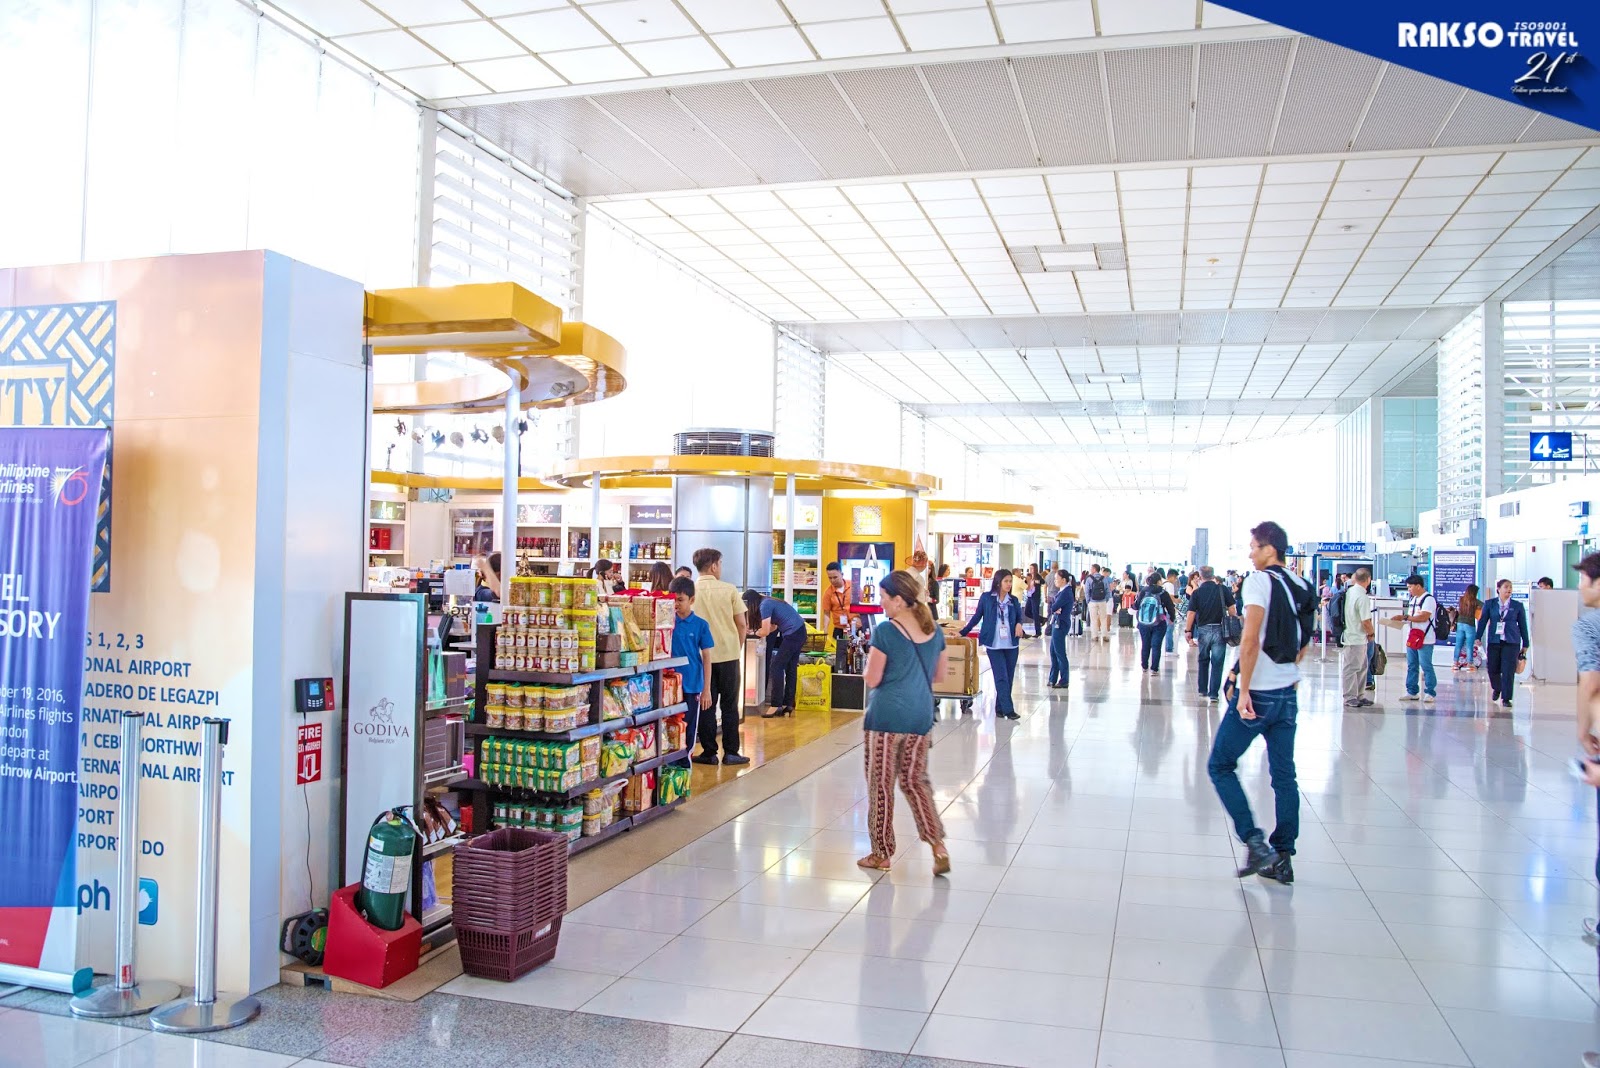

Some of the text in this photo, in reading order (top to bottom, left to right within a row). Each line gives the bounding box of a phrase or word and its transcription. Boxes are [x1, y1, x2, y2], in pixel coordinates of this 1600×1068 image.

[0, 377, 65, 426] TY
[1533, 435, 1552, 458] 4
[0, 480, 35, 494] rlines
[0, 573, 30, 602] EL
[0, 608, 62, 640] SORY
[98, 632, 111, 650] 1,
[116, 633, 130, 651] 2,
[135, 634, 144, 649] 3
[128, 659, 192, 678] AIRPORT
[0, 684, 19, 699] ber
[84, 682, 219, 706] ADERO DE LEGAZPI
[38, 706, 74, 726] flights
[0, 724, 29, 739] ndon
[298, 726, 322, 741] FIRE
[353, 722, 410, 738] GODIVA
[93, 733, 122, 750] CEB
[0, 743, 51, 762] depart at
[0, 762, 34, 779] throw
[79, 783, 119, 801] AIRPO
[78, 833, 165, 857] RPOR DO
[77, 878, 111, 916] ph
